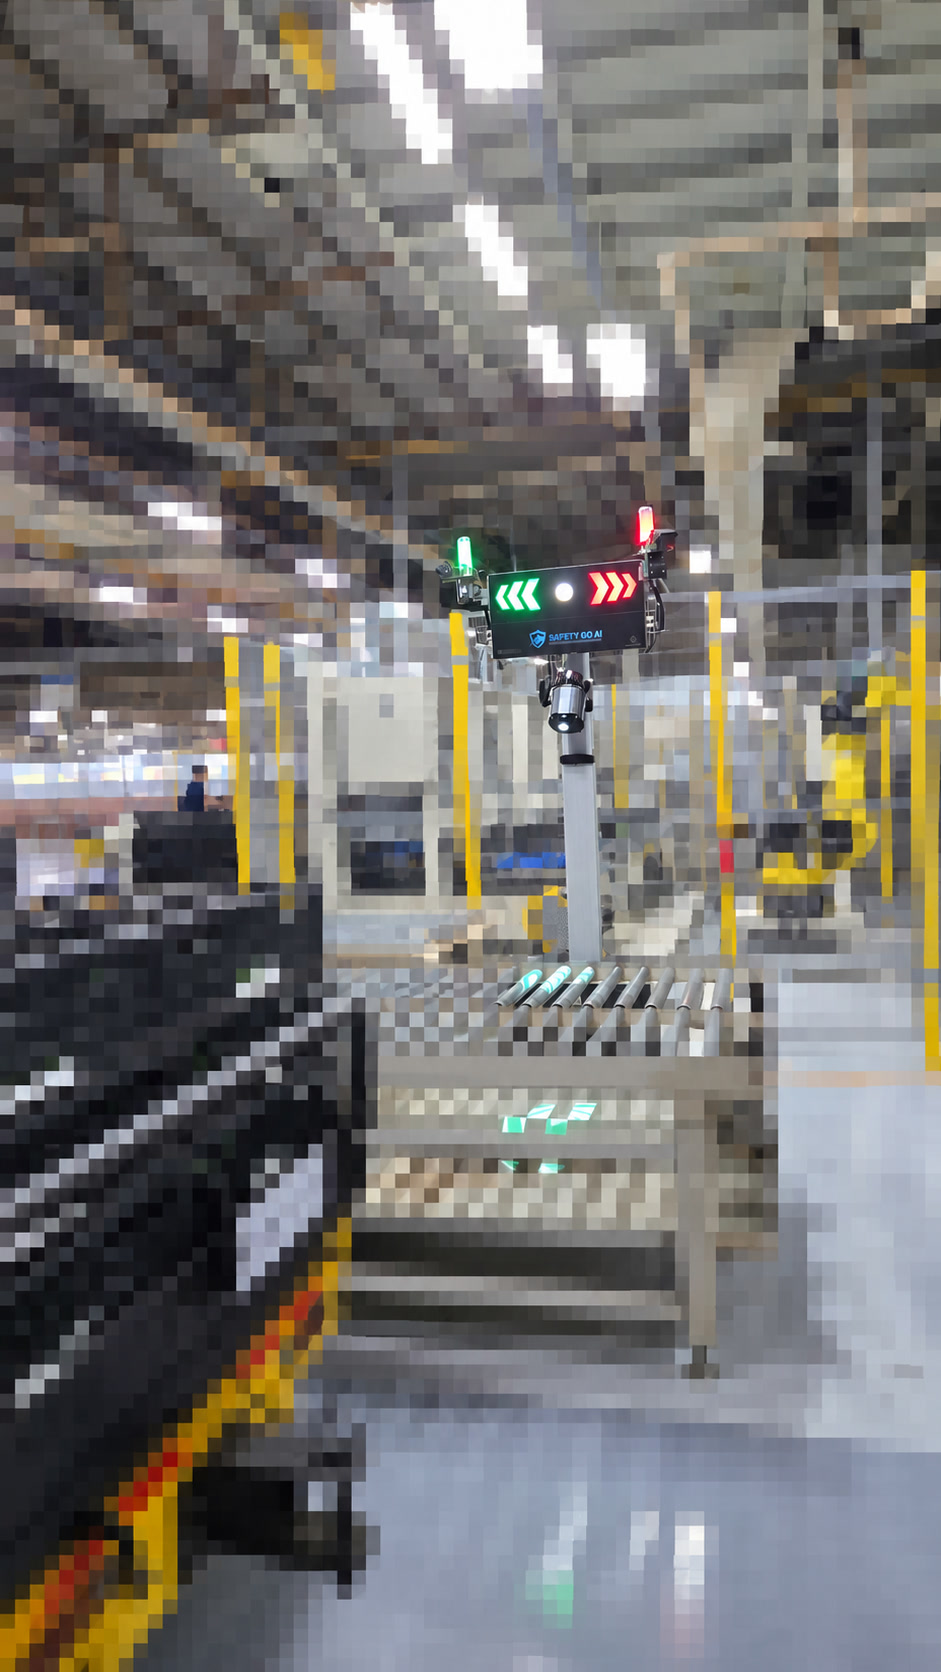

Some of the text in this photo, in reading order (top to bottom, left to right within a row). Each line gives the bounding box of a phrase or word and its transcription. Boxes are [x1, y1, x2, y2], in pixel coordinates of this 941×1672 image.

[549, 630, 602, 641] SAFETY GO AI
